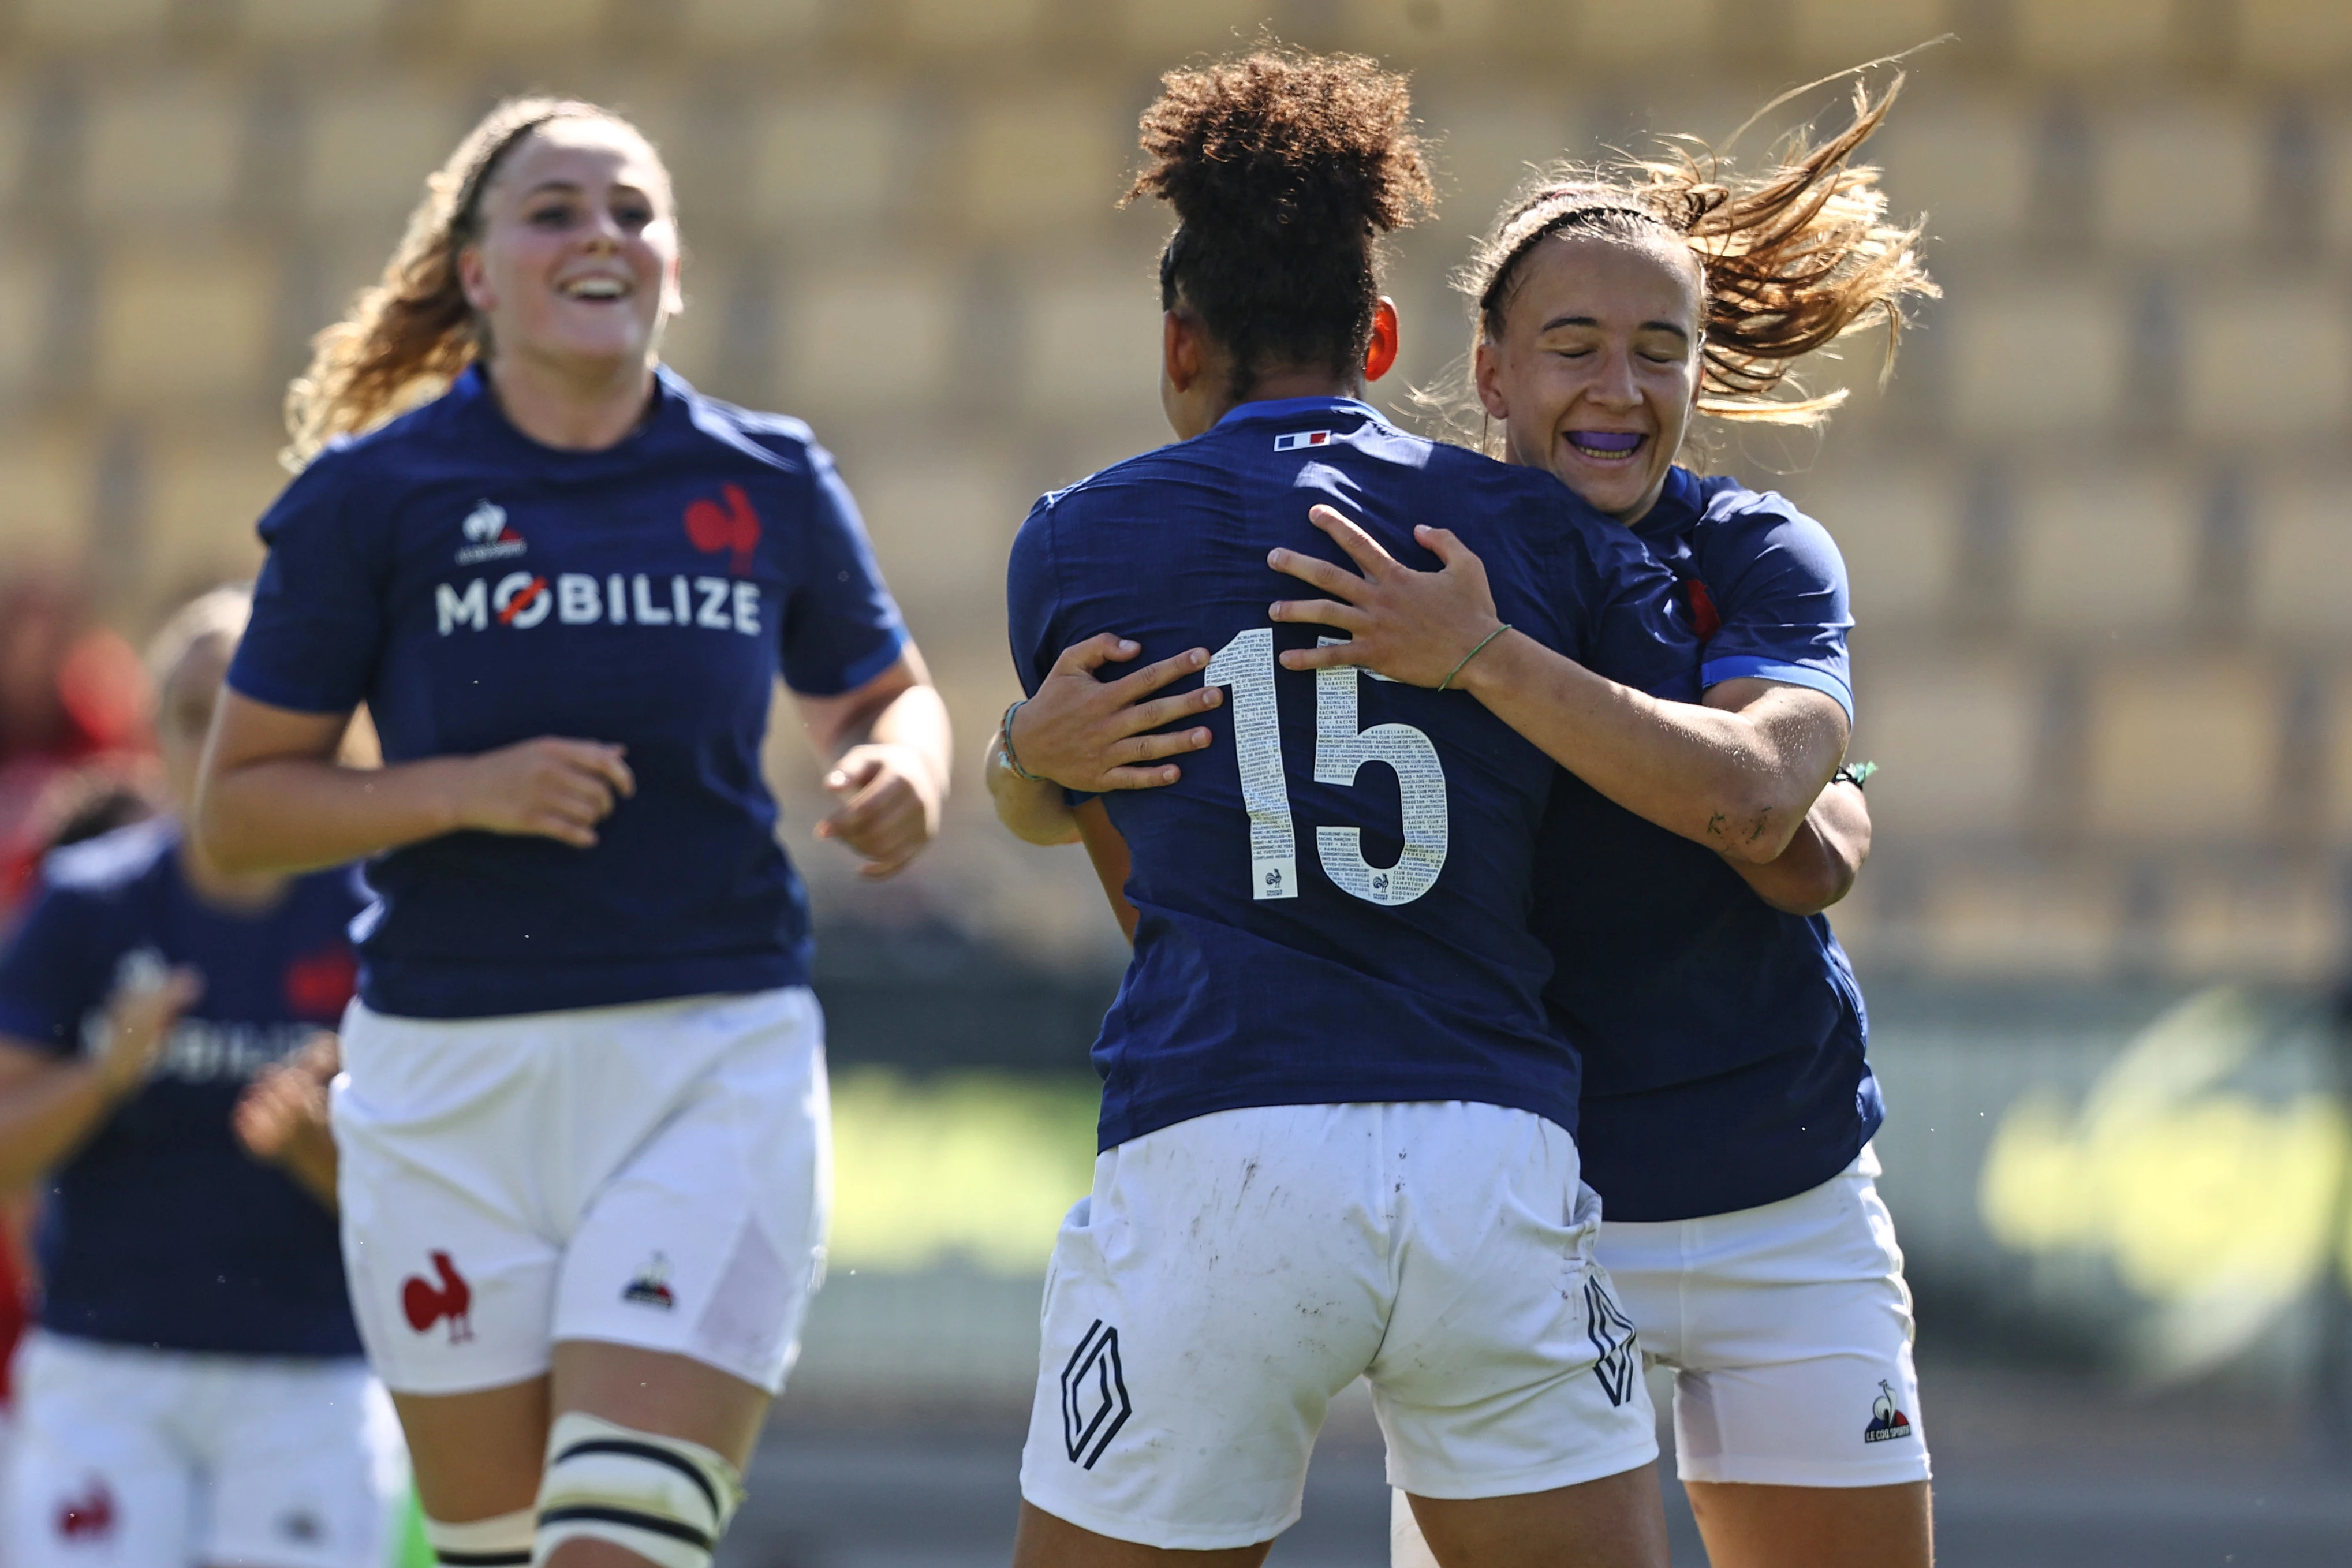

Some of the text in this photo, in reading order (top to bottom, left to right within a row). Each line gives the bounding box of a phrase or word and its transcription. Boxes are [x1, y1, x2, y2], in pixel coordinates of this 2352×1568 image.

[435, 570, 762, 637] MOBILIZE
[1204, 628, 1448, 906] 15
[1866, 1431, 1875, 1442] LE
[1876, 1428, 1889, 1440] COQ
